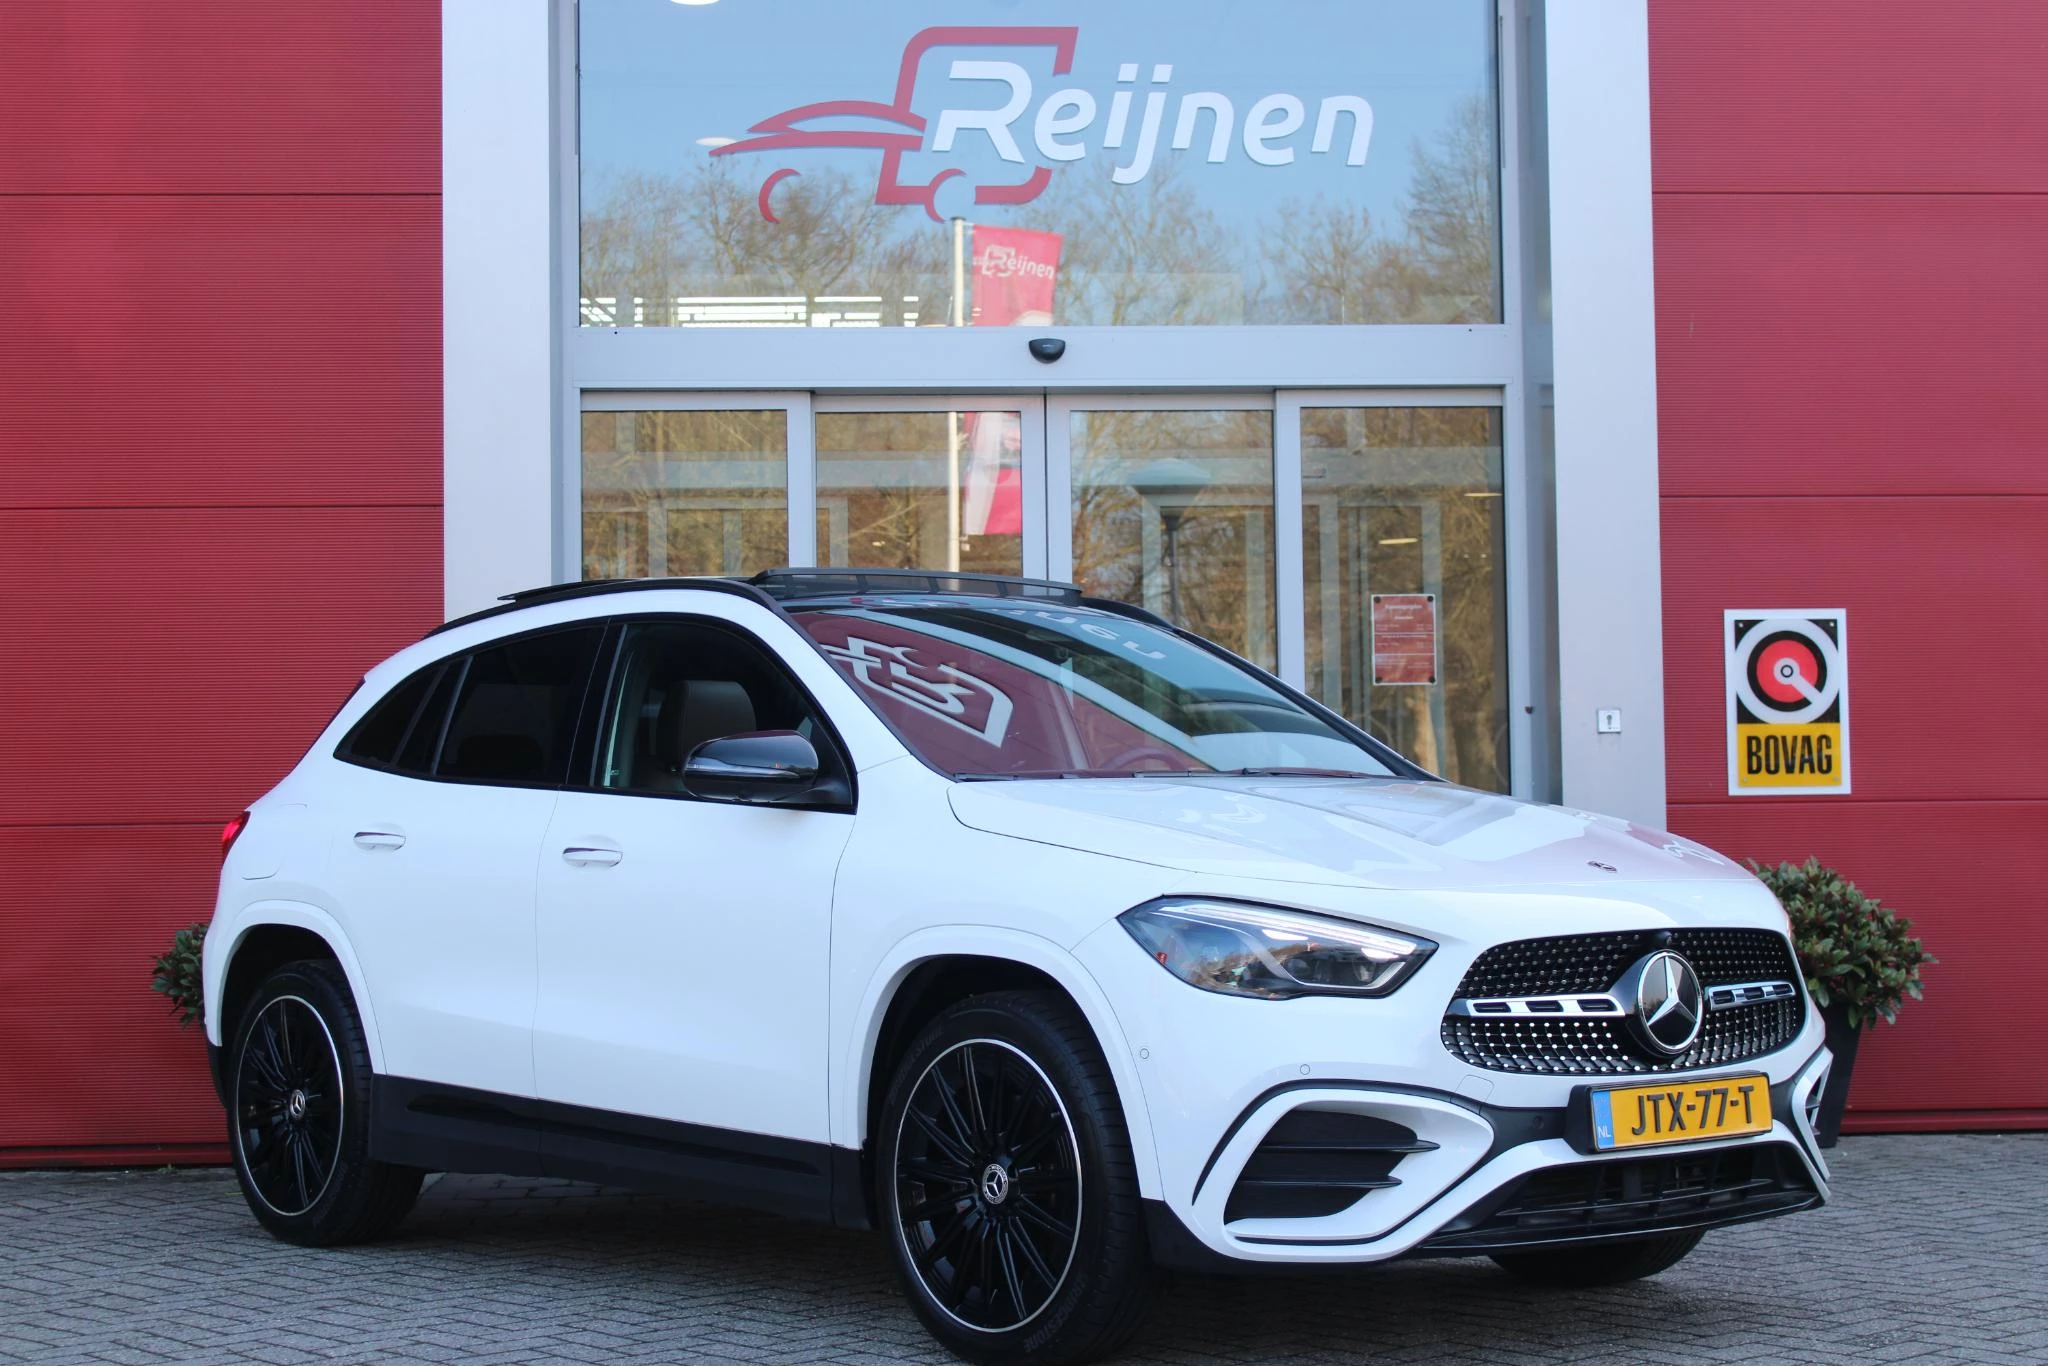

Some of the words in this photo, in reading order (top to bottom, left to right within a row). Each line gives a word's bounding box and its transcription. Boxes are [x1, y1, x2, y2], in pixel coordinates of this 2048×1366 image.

[933, 61, 1374, 185] Reijnen
[988, 246, 1055, 280] Reijnen
[1746, 734, 1833, 775] BOVAG
[1632, 1085, 1754, 1136] JTX-77-T
[1597, 1126, 1612, 1138] NL
